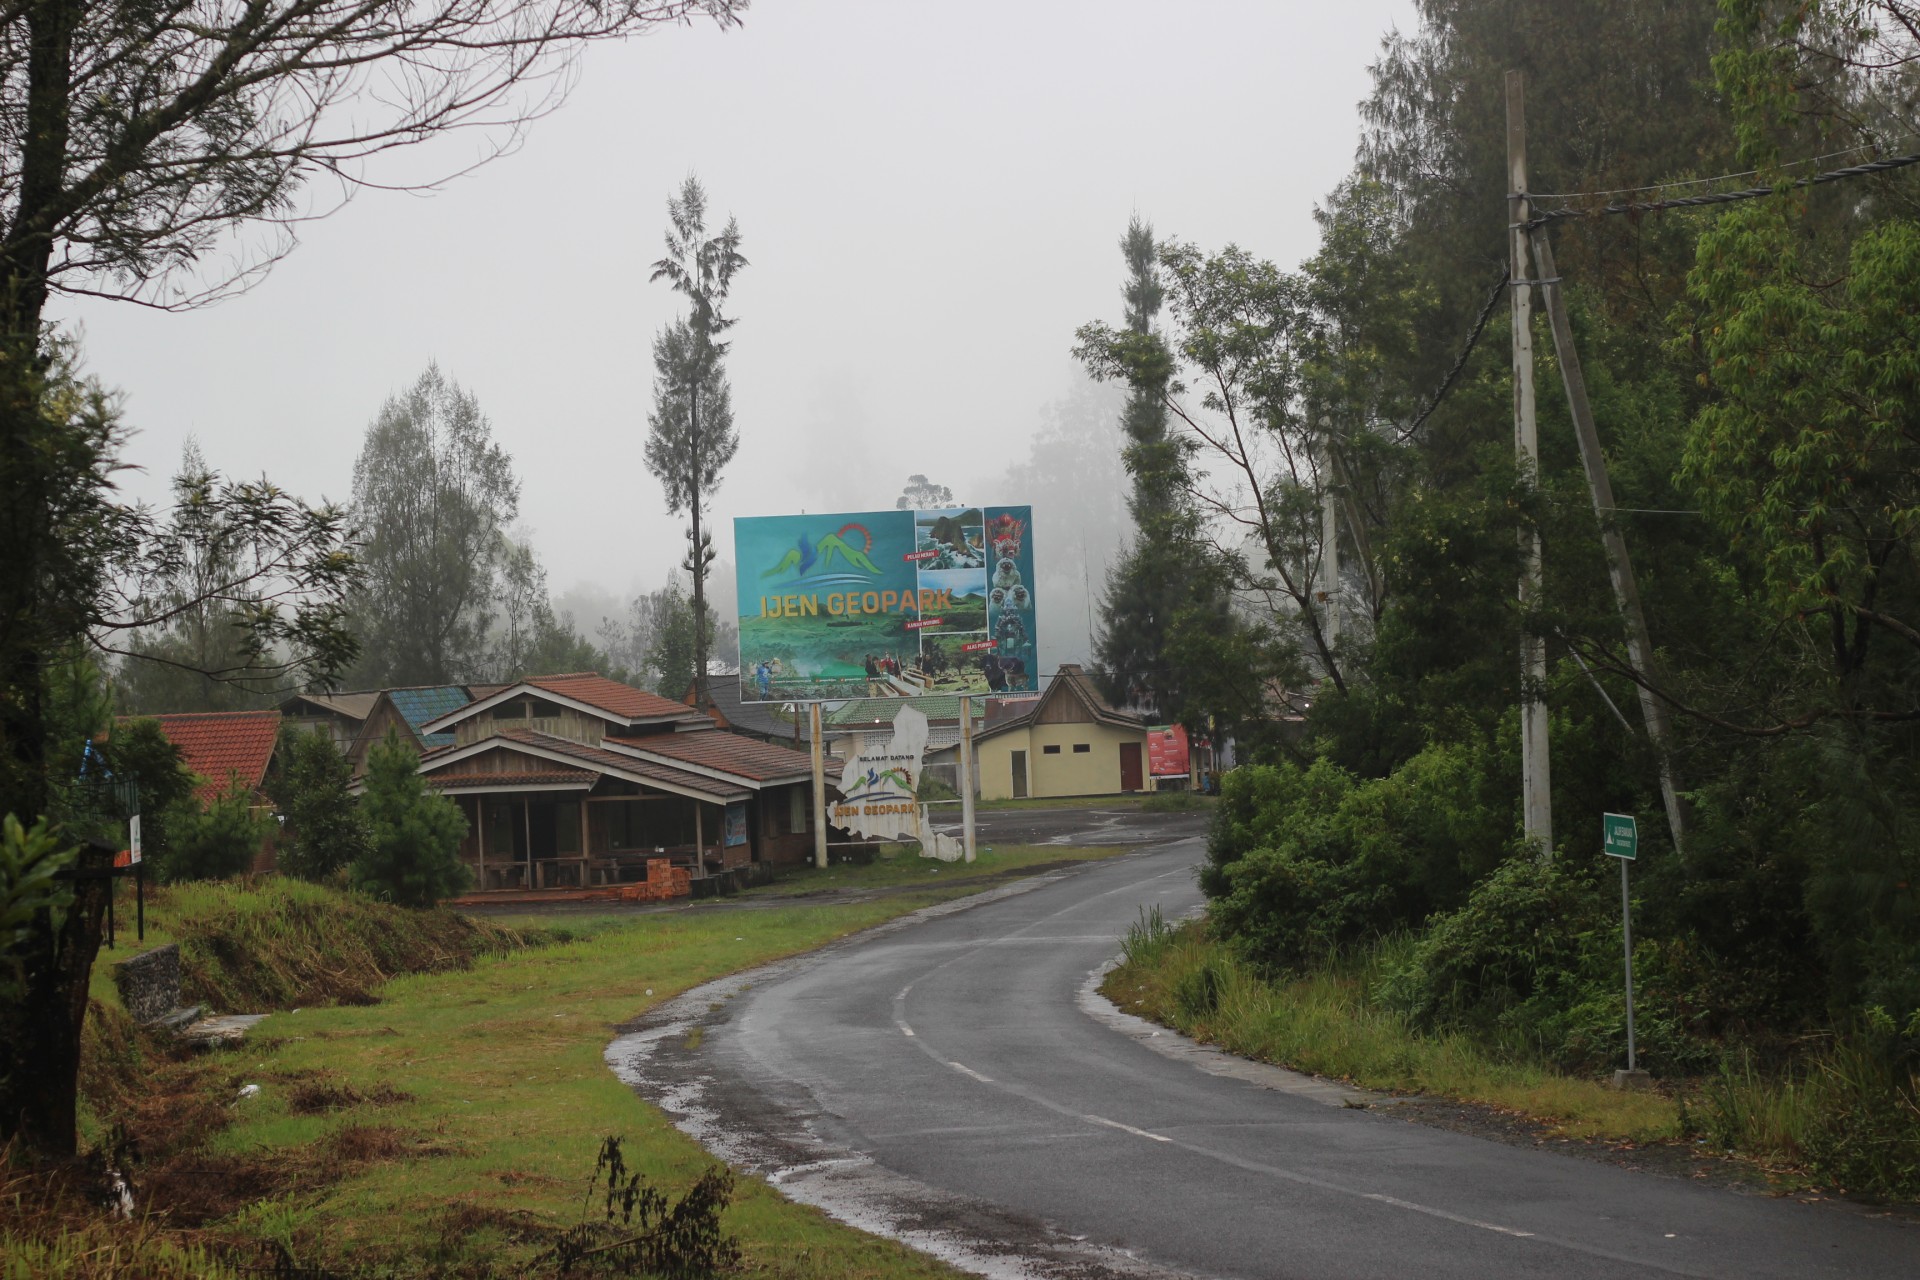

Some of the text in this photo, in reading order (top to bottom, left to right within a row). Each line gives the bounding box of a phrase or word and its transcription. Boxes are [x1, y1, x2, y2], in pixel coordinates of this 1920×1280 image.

[761, 588, 952, 618] IJEN GEOPARK
[863, 804, 914, 815] GEOPARK
